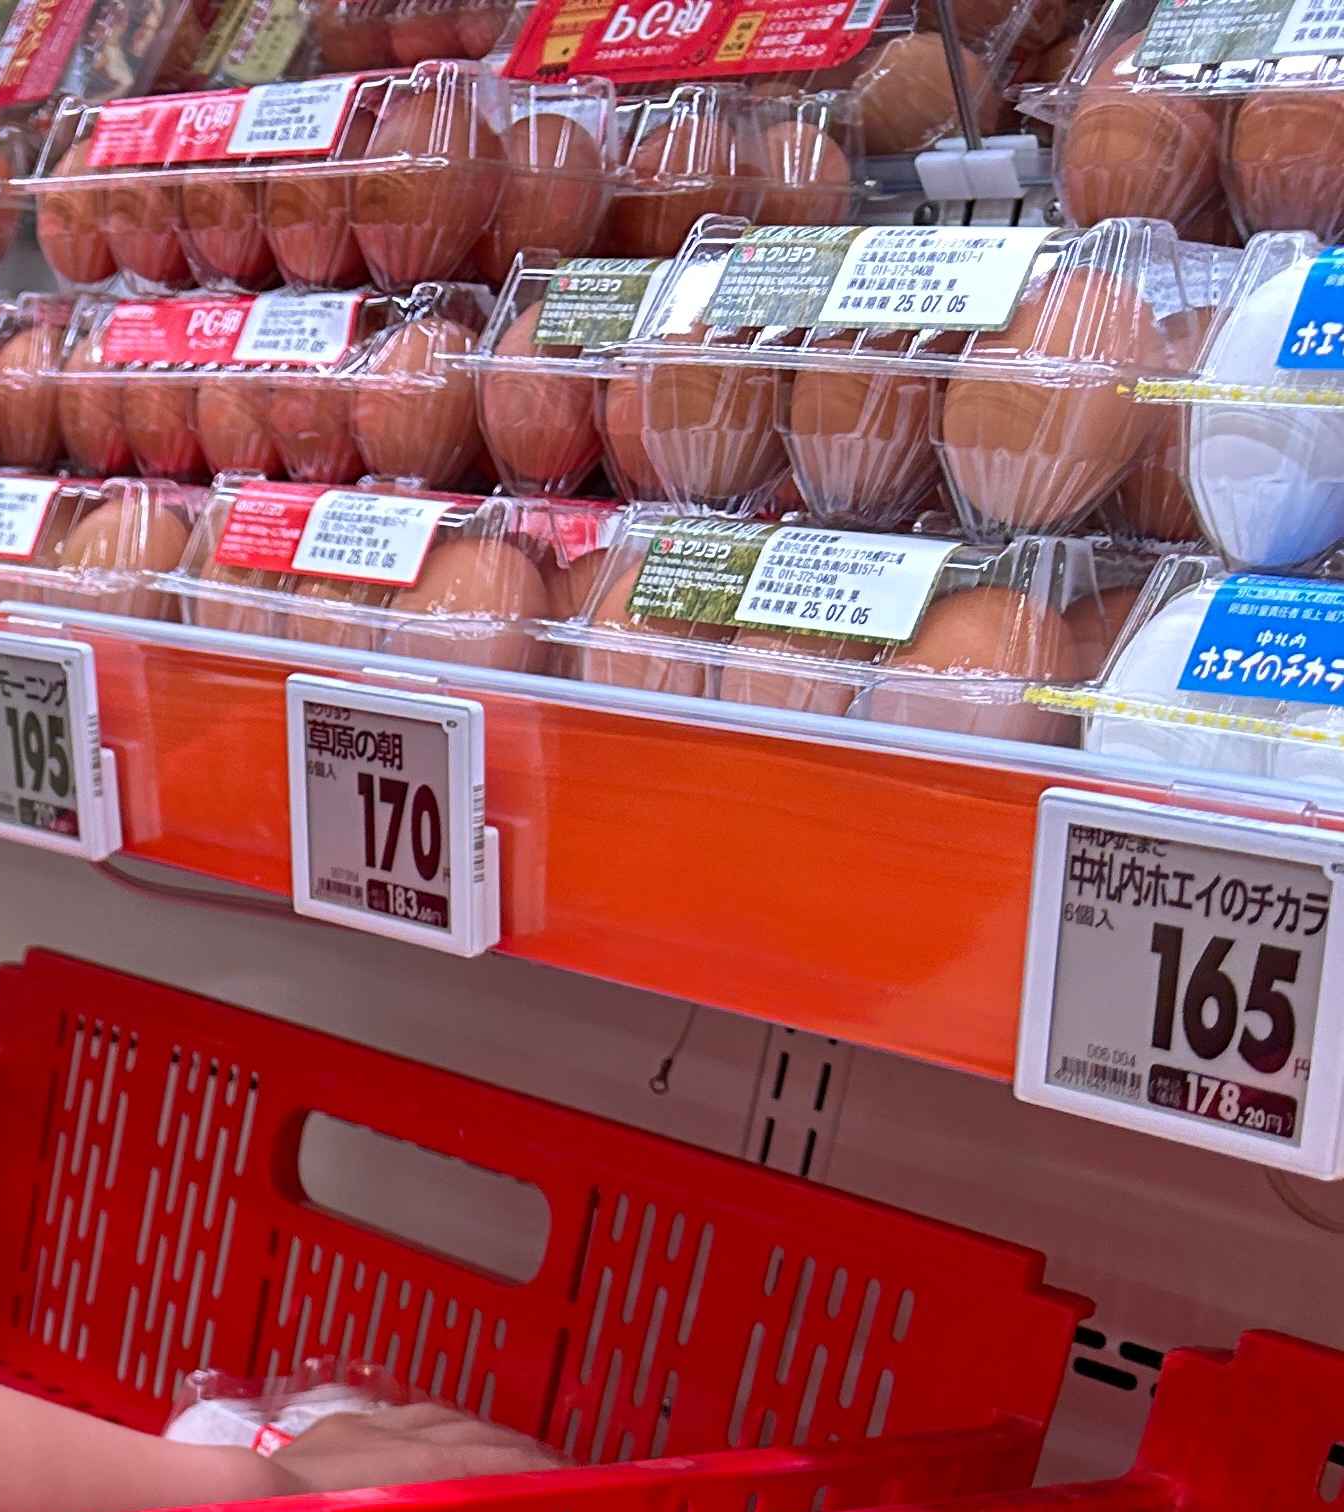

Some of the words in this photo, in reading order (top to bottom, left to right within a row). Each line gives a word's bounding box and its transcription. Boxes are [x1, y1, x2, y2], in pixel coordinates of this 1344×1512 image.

[176, 102, 236, 132] PG卵
[853, 264, 866, 276] TEL
[186, 308, 245, 337] PG卵
[1290, 320, 1344, 357] ホエ
[670, 539, 732, 559] ホクリヨウ
[760, 565, 775, 579] TEL
[747, 596, 798, 615] 賞味期限
[1256, 629, 1307, 649] 中札内
[1192, 645, 1344, 693] ホエイのチカラ
[4, 705, 70, 798] 195
[307, 718, 404, 771] 草原の朝
[357, 771, 442, 881] 170
[1069, 848, 1330, 937] 中札内ホエイのチカラ
[1063, 903, 1115, 931] 6個入
[1150, 921, 1303, 1075] 165
